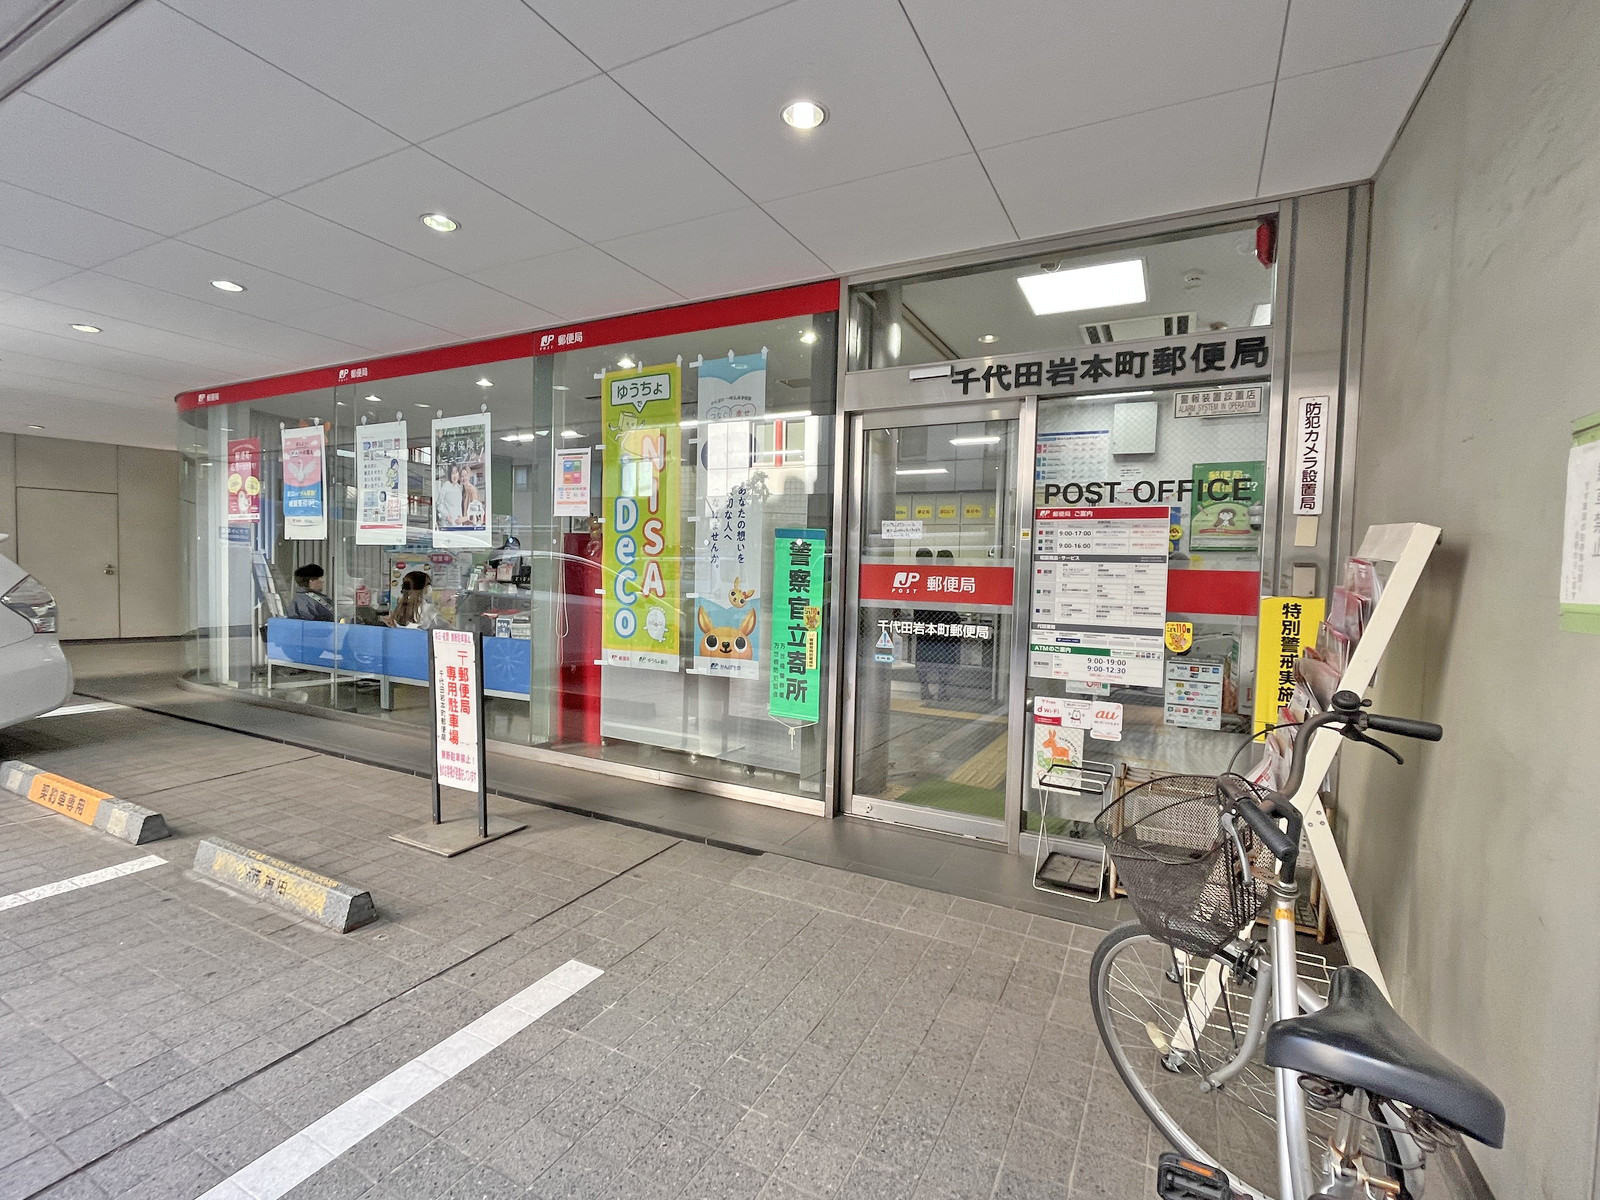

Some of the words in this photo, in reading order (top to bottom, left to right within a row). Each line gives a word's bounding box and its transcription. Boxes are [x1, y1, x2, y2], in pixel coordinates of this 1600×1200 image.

[557, 331, 583, 346] 郵便局
[351, 367, 368, 378] 郵便局
[951, 335, 1270, 395] 千代田岩本町郵便局
[617, 381, 663, 400] ゆうちょ
[1180, 389, 1256, 405] 警報装置設置店
[1179, 404, 1196, 412] ALARM
[1197, 402, 1219, 412] SYSTEM
[1228, 400, 1257, 410] OPERATION
[1300, 401, 1322, 511] 防犯カメラ設置局
[1045, 481, 1121, 504] POST
[1133, 478, 1253, 503] OFFICE
[642, 434, 665, 598] NISA
[892, 572, 920, 588] JP
[926, 575, 976, 594] 郵便局
[786, 540, 812, 703] 警察官立寄所
[877, 620, 989, 640] 千代田岩本町郵便局
[1034, 645, 1072, 653] ATMのご案内
[1277, 602, 1302, 714] 特別警戒実施
[1087, 656, 1127, 667] 9:00-19:00
[1087, 665, 1127, 674] 9:00-12:30
[446, 665, 459, 746] 専用駐車場
[1095, 710, 1120, 720] au
